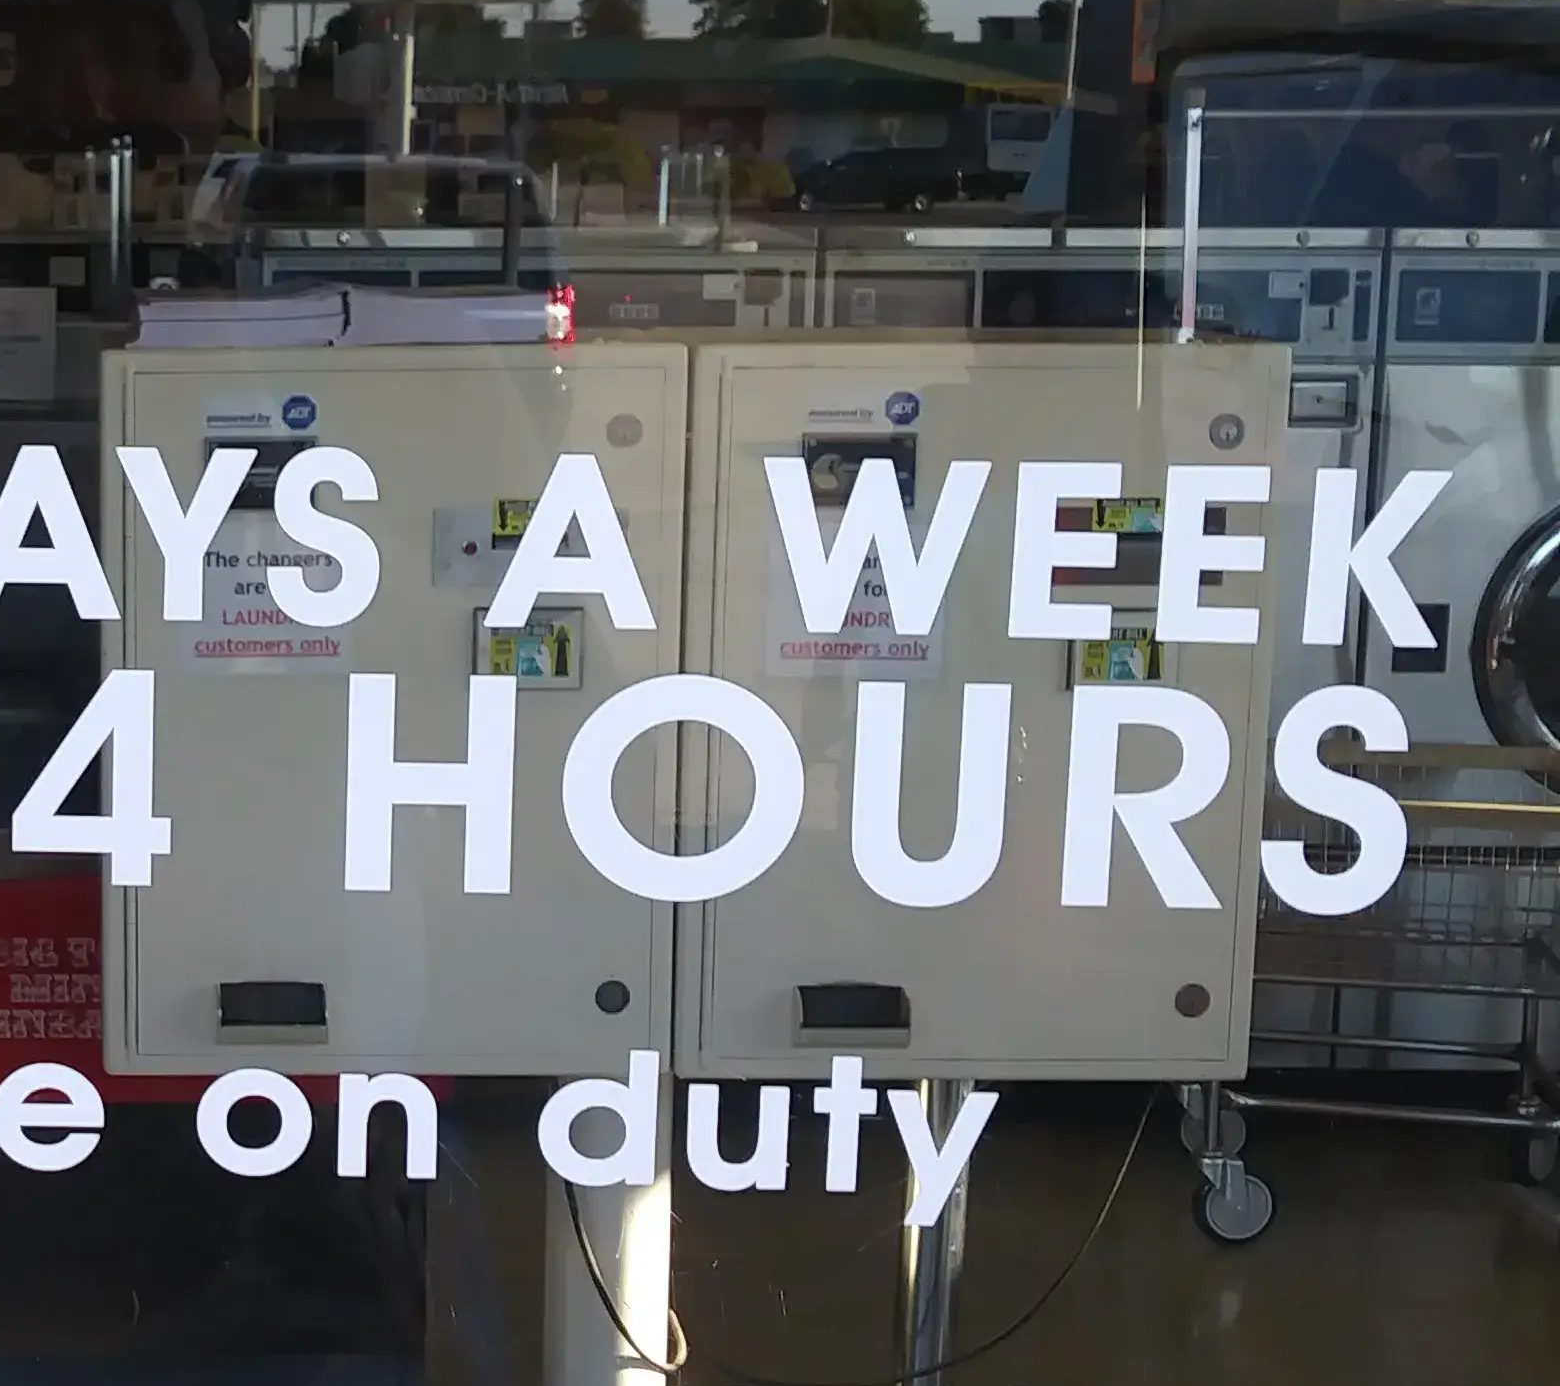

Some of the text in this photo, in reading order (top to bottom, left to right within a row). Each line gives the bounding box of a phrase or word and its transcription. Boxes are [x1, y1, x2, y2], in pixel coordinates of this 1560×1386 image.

[204, 550, 333, 569] The changers
[482, 452, 658, 631] A
[762, 455, 1454, 649] WEEK
[234, 580, 267, 596] are
[863, 580, 888, 598] fo
[221, 608, 293, 626] LAUND
[194, 636, 341, 656] customers only
[779, 640, 930, 660] customers only
[343, 672, 1410, 916] HOURS
[9, 973, 102, 1003] MIN
[195, 1067, 438, 1180] on
[537, 1049, 1000, 1228] duty
